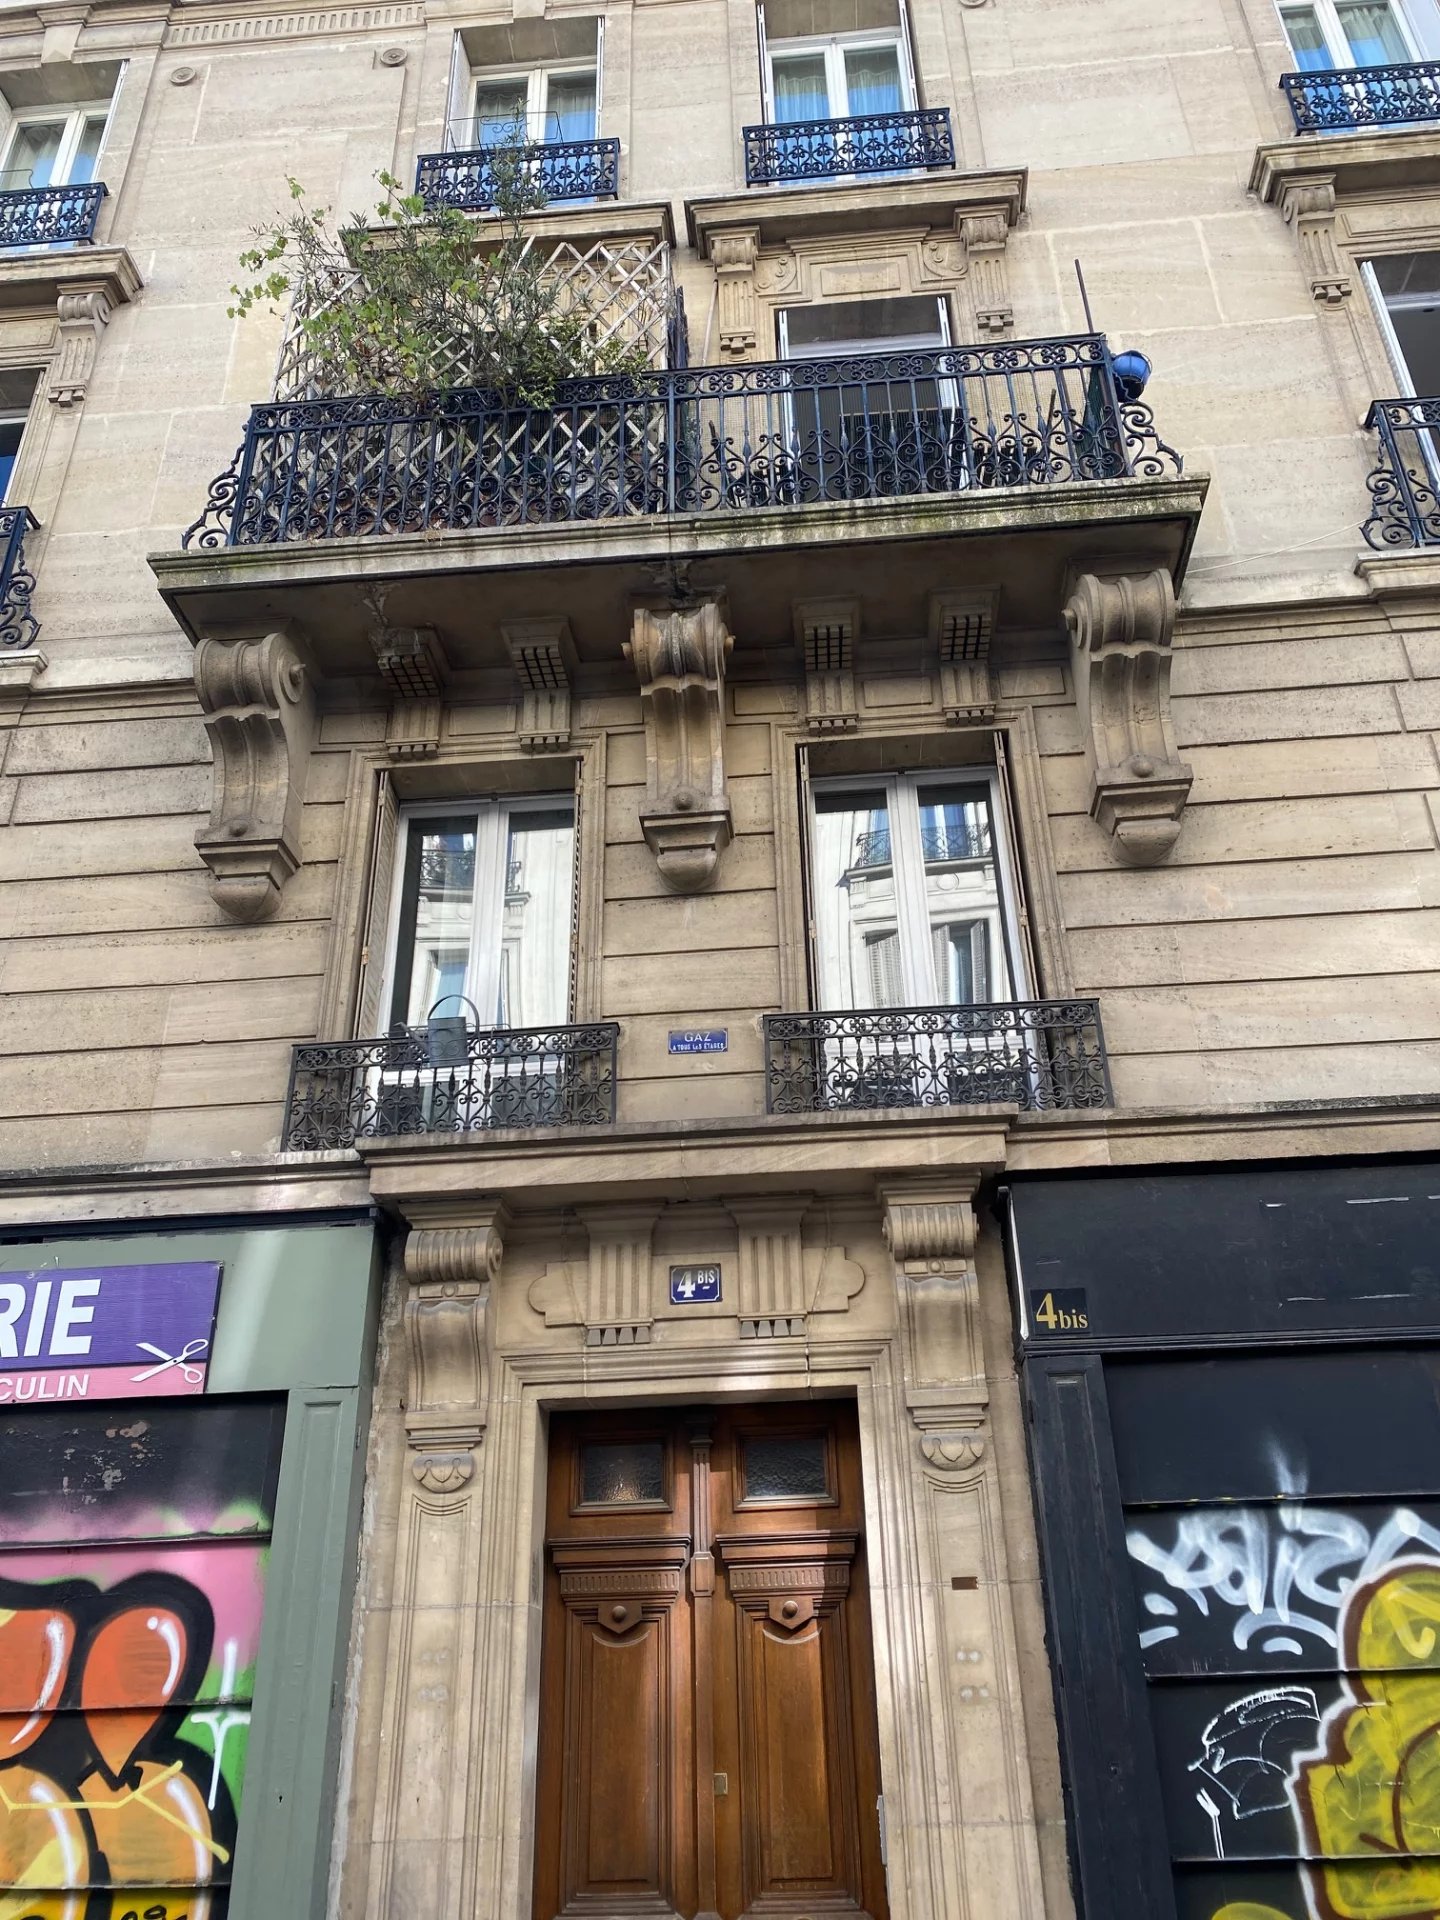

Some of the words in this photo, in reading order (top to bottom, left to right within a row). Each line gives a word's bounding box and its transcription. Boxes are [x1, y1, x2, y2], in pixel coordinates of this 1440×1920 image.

[684, 1031, 712, 1042] GAZ
[677, 1270, 696, 1298] 4
[697, 1270, 715, 1284] BIS
